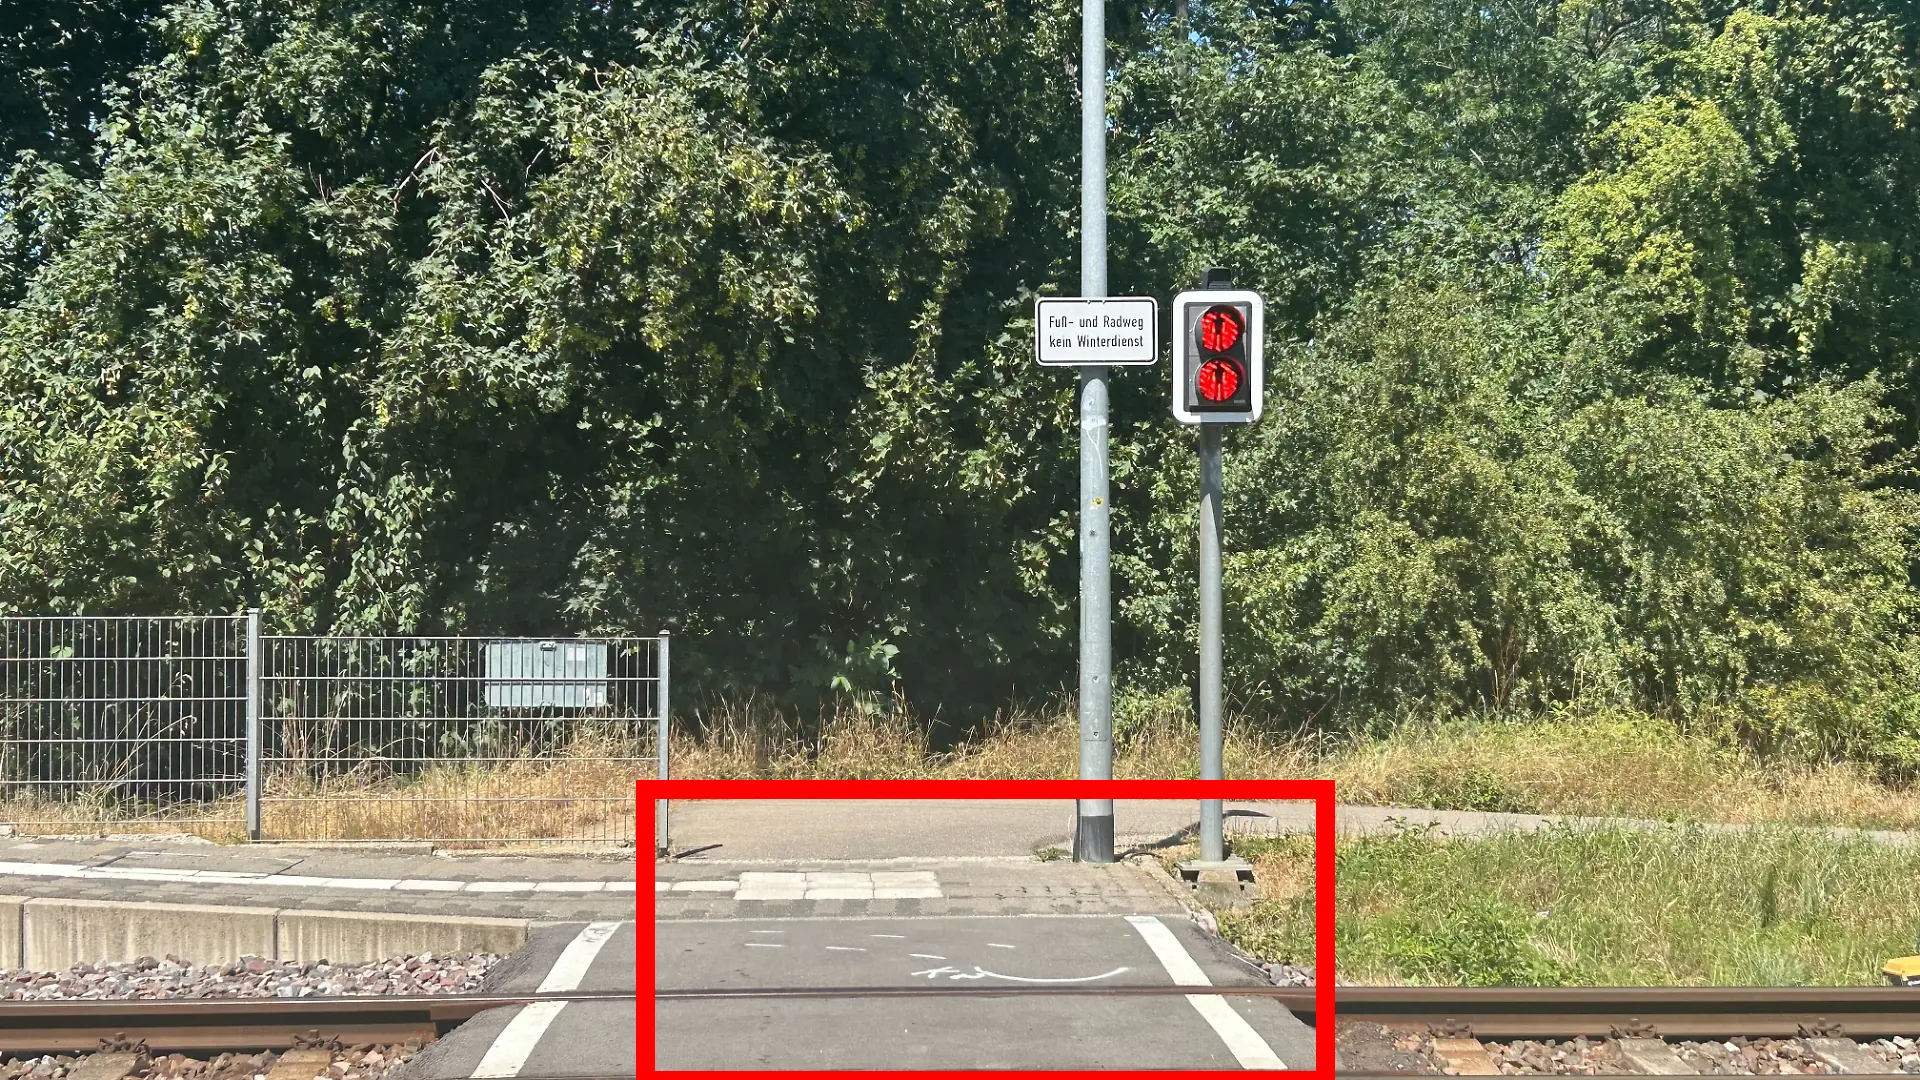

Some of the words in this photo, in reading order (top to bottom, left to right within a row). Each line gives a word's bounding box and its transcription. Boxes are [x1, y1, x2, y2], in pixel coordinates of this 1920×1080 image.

[1049, 316, 1074, 328] Fuß-
[1079, 316, 1098, 328] und
[1103, 315, 1144, 330] Radweg
[1049, 335, 1072, 348] kein
[1077, 335, 1144, 348] Winterdienst
